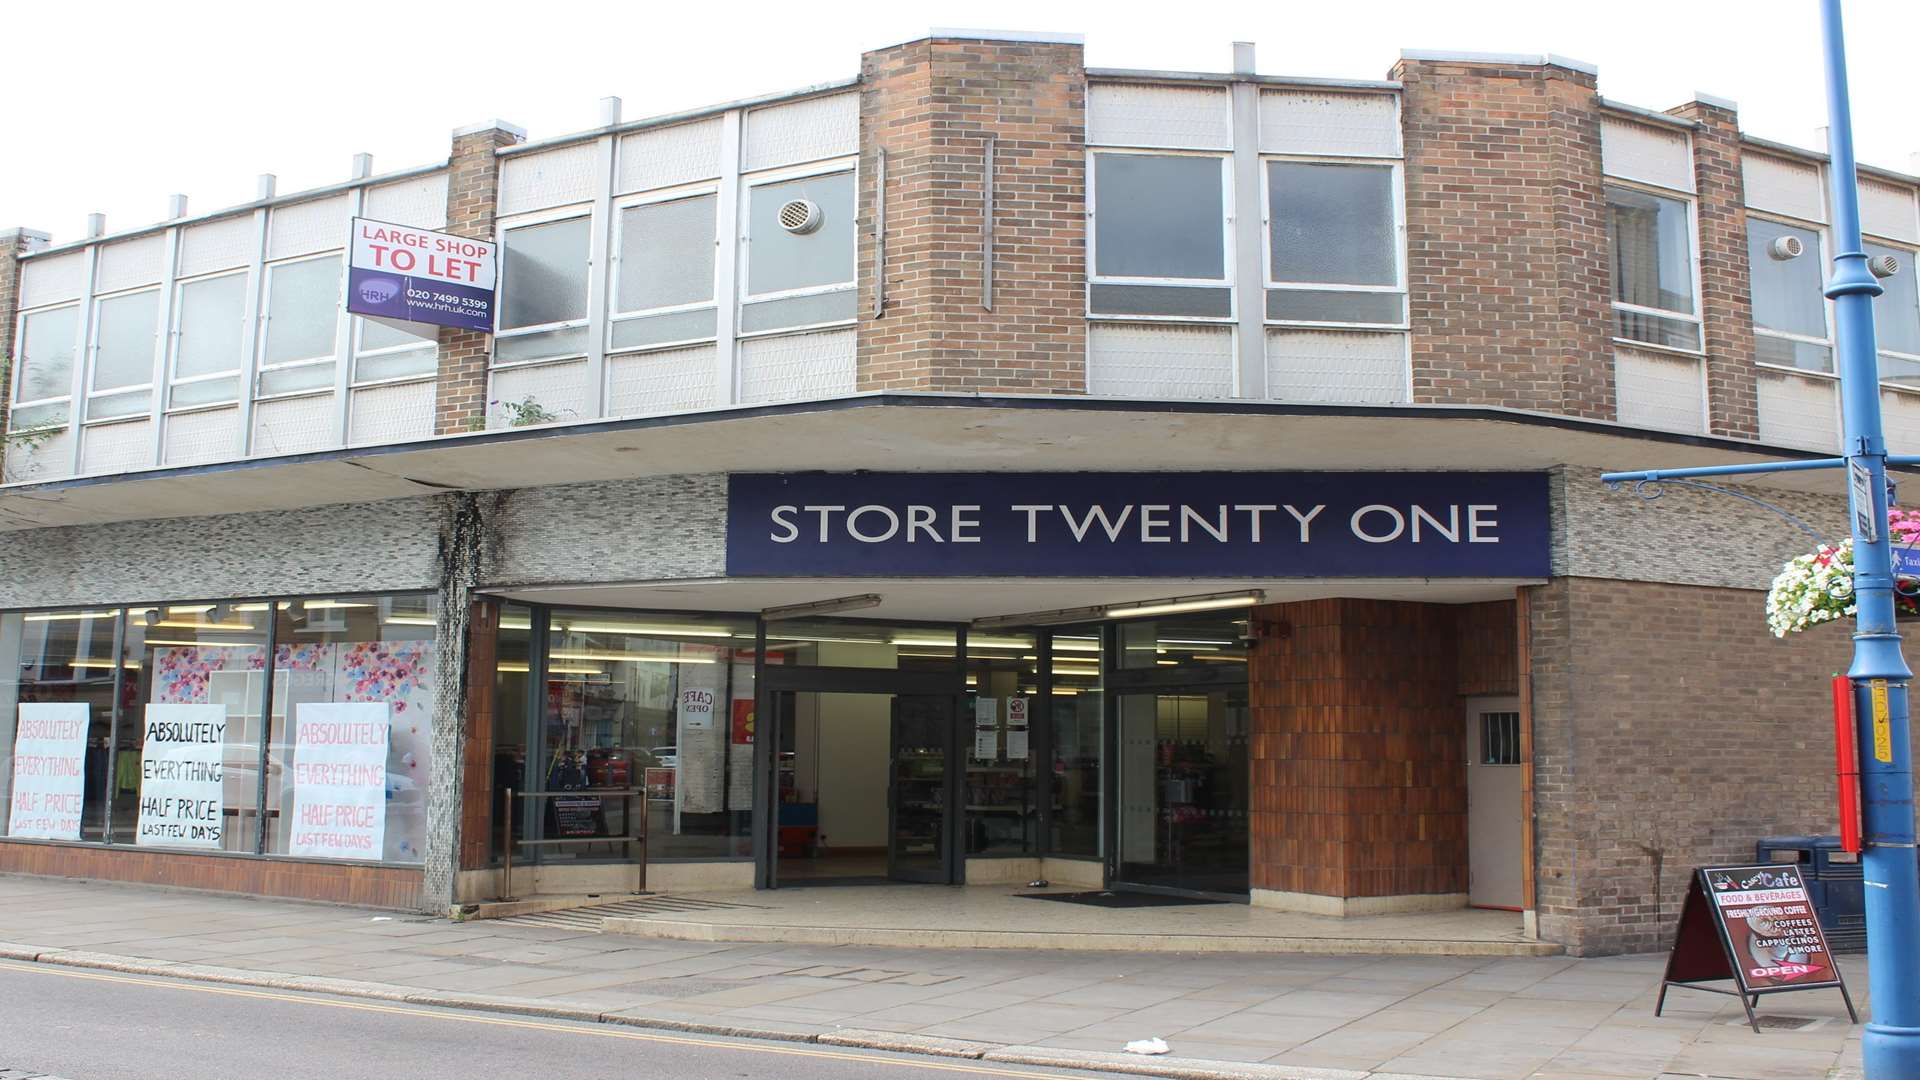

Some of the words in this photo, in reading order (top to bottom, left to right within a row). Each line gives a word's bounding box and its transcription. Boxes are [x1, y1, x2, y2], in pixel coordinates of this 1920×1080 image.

[363, 225, 428, 249] LARGE
[436, 238, 488, 258] SHOP
[368, 244, 416, 272] TO
[428, 254, 482, 282] LET
[361, 288, 390, 302] HRH
[406, 288, 430, 300] 020
[433, 294, 459, 305] 7499
[462, 298, 488, 310] 5399
[406, 299, 487, 319] www.hrh.uk.com
[770, 504, 981, 543] STORE
[1011, 504, 1326, 543] TWENTY
[1350, 504, 1500, 543] ONE
[19, 720, 83, 742] ABSOLUTELY
[146, 722, 226, 744] ABSOLUTELY
[298, 722, 388, 745] ABSOLUTELY
[16, 756, 80, 777] EVERYTHING
[144, 760, 223, 782] EVERYTHING
[296, 764, 384, 786] EVERYTHING
[15, 791, 40, 812] HALF
[45, 793, 81, 814] PRICE
[141, 797, 172, 818] HALF
[178, 800, 217, 821] PRICE
[15, 818, 34, 830] LAST
[36, 818, 56, 831] FEW
[60, 819, 80, 832] DAYS
[301, 804, 333, 826] HALF
[335, 804, 375, 828] PRICE
[142, 824, 166, 838] LAST
[167, 825, 187, 838] FEW
[191, 826, 221, 841] DAYS
[296, 831, 320, 846] LAST
[321, 832, 342, 848] FEW
[344, 834, 372, 850] DAYS
[1762, 872, 1798, 888] Cafe
[1720, 894, 1744, 903] FOOD
[1755, 890, 1801, 902] BEVERAGES
[1754, 906, 1784, 918] GROUND
[1784, 905, 1807, 915] COFFEE
[1774, 918, 1812, 928] COFFEES
[1783, 928, 1816, 936] LATTES
[1756, 936, 1819, 947] CAPPUCCINOS
[1798, 945, 1823, 953] MORE
[1751, 965, 1809, 977] OPEN
